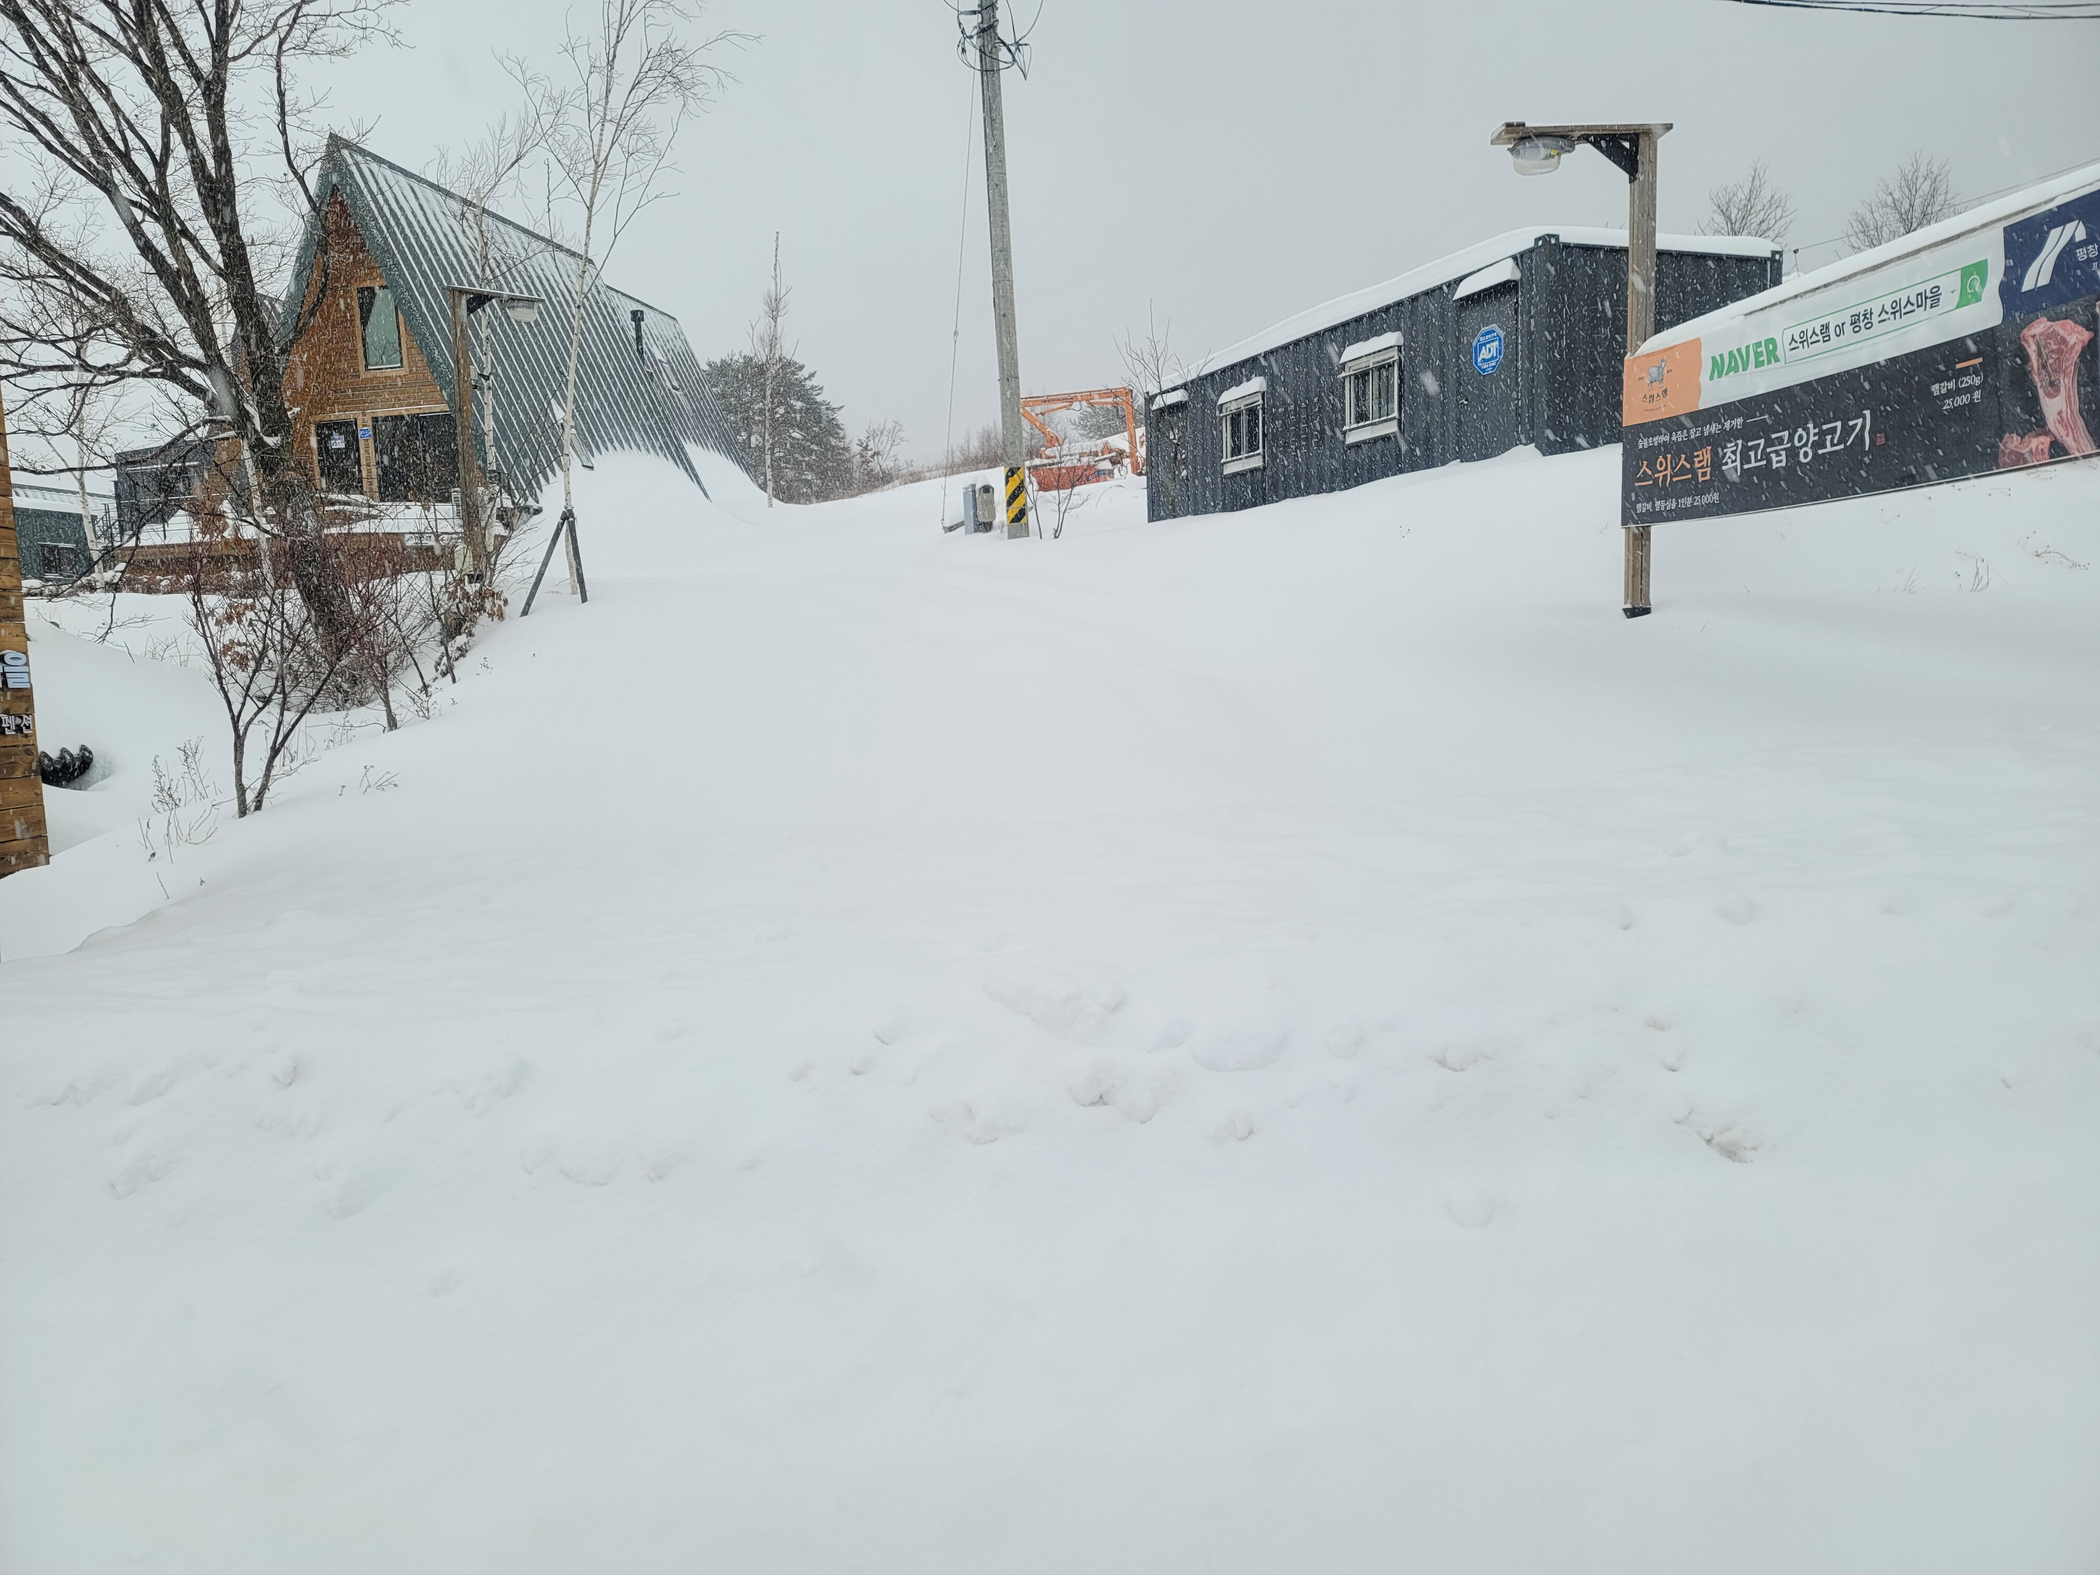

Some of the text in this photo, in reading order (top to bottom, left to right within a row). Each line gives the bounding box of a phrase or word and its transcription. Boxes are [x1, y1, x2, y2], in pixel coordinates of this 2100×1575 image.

[1788, 285, 1942, 352] 스위스램 or 평창 스위스마을
[1478, 341, 1499, 361] ADT
[1709, 337, 1780, 381] NAVER
[1931, 371, 1984, 396] 램갈비 (250g)
[1942, 389, 1982, 410] 25,000 원
[1634, 446, 1712, 488] 스위스램
